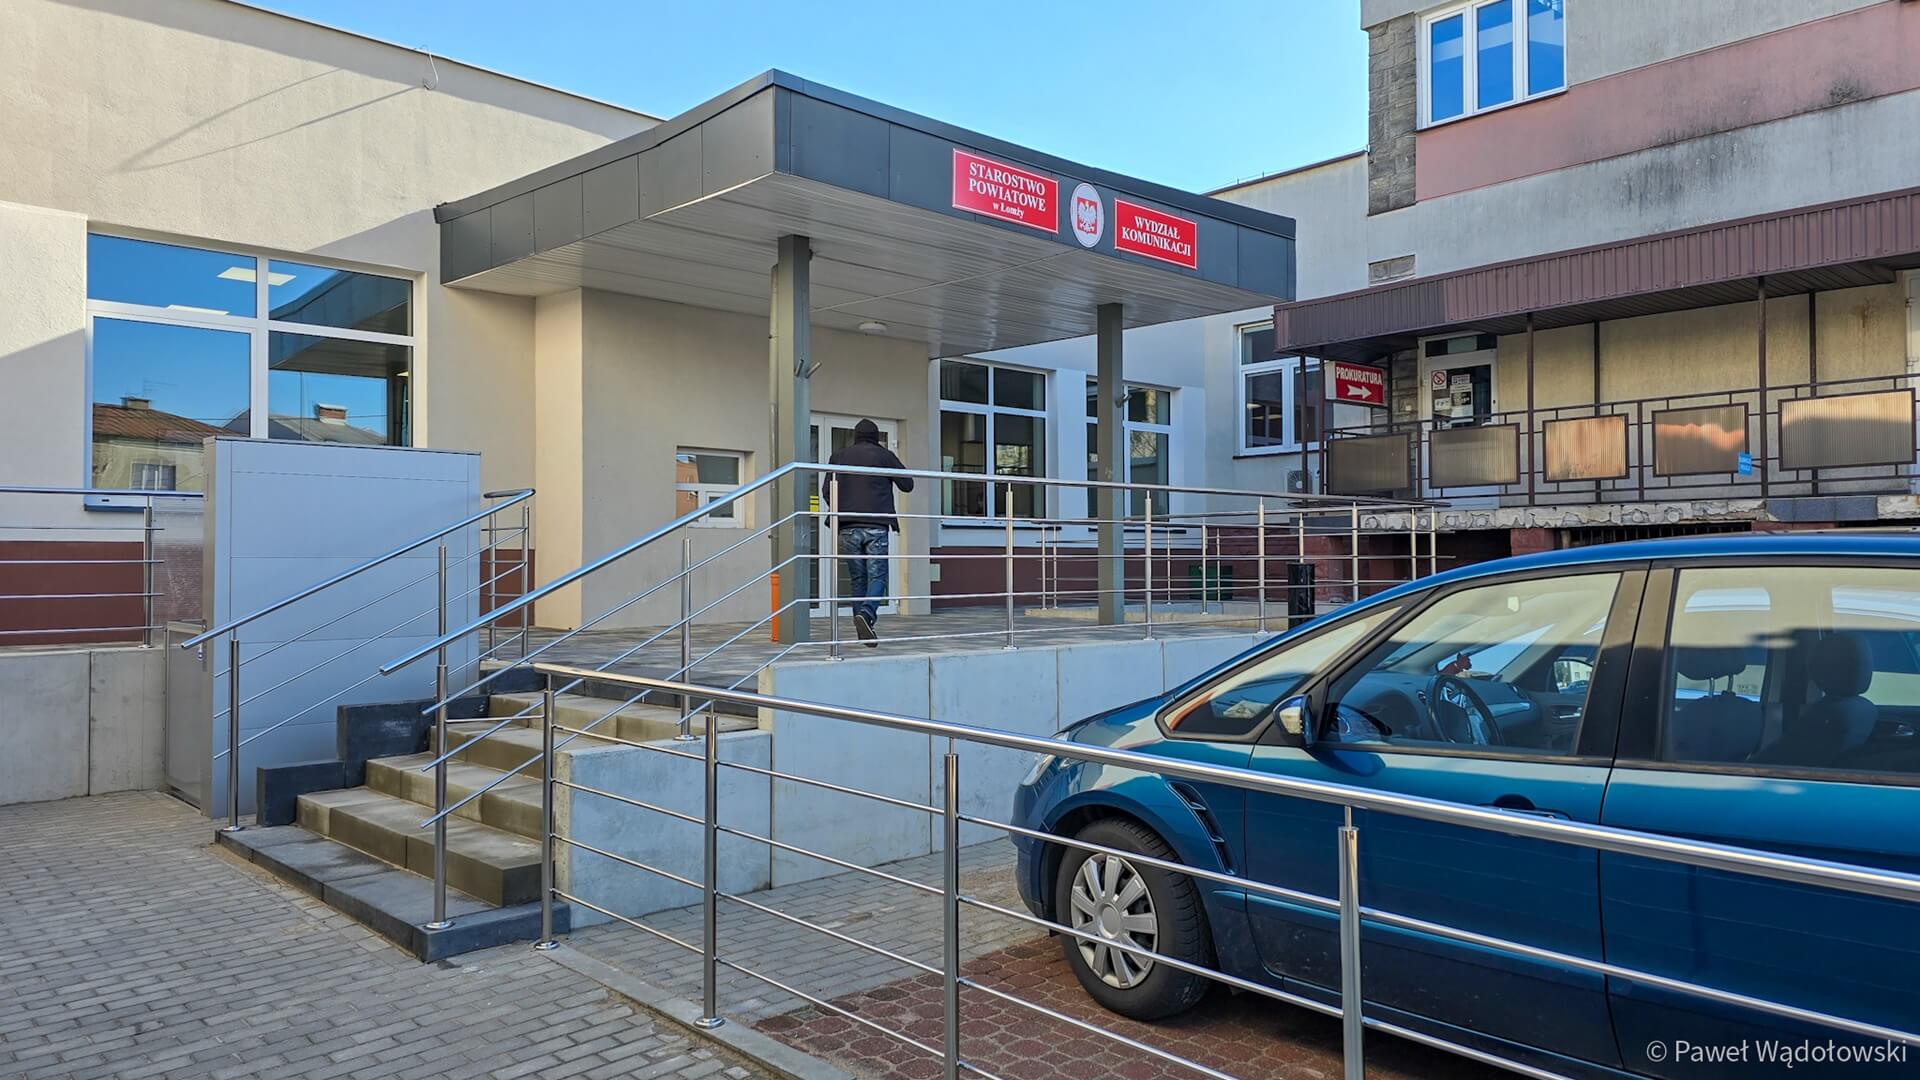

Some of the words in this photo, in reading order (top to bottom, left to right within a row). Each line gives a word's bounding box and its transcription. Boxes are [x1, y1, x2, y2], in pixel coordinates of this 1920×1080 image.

[969, 162, 1045, 196] STAROSTWO
[968, 177, 1046, 212] POWIATOWE
[992, 202, 999, 210] w
[1000, 202, 1024, 219] Łomży
[1122, 226, 1191, 257] KOMUNIKACJI
[1134, 215, 1180, 240] WYDZIAŁ
[1336, 367, 1383, 386] PROKURATURA
